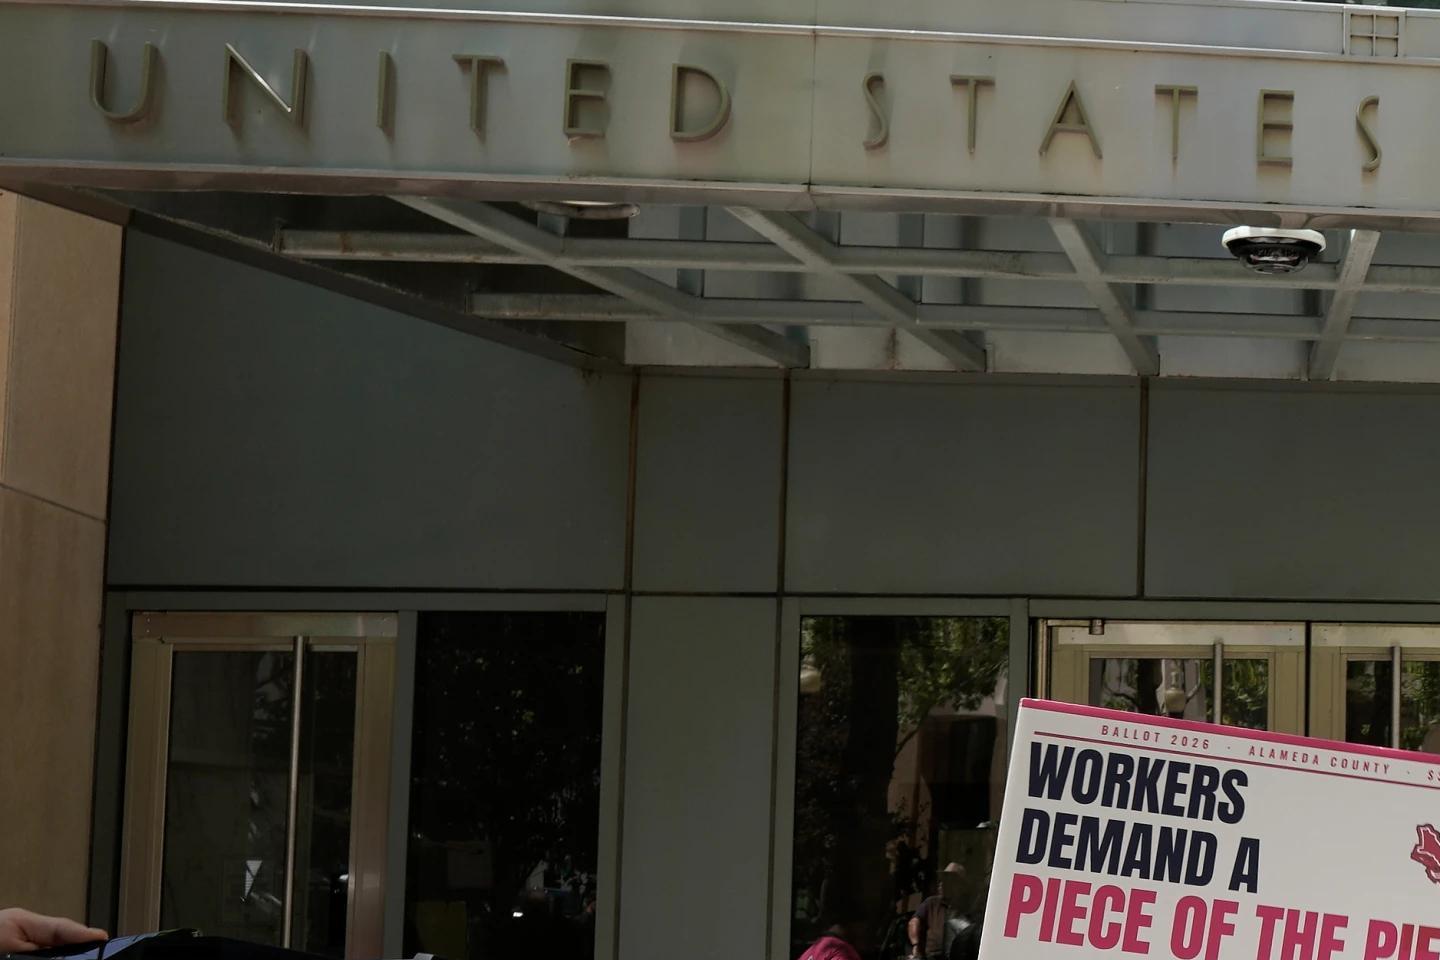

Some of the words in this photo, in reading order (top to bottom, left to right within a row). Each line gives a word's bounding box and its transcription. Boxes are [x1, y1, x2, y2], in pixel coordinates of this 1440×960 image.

[89, 38, 732, 143] UNITED
[861, 72, 1382, 174] STATES
[1028, 741, 1249, 825] WORKERS
[1101, 725, 1162, 743] BALLOT
[1171, 734, 1210, 750] 2026
[1249, 745, 1319, 765] ALAMEDA
[1330, 757, 1390, 774] COUNTY
[1016, 807, 1218, 887] DEMAND
[1228, 836, 1261, 894] A
[1003, 872, 1157, 955] PIECE
